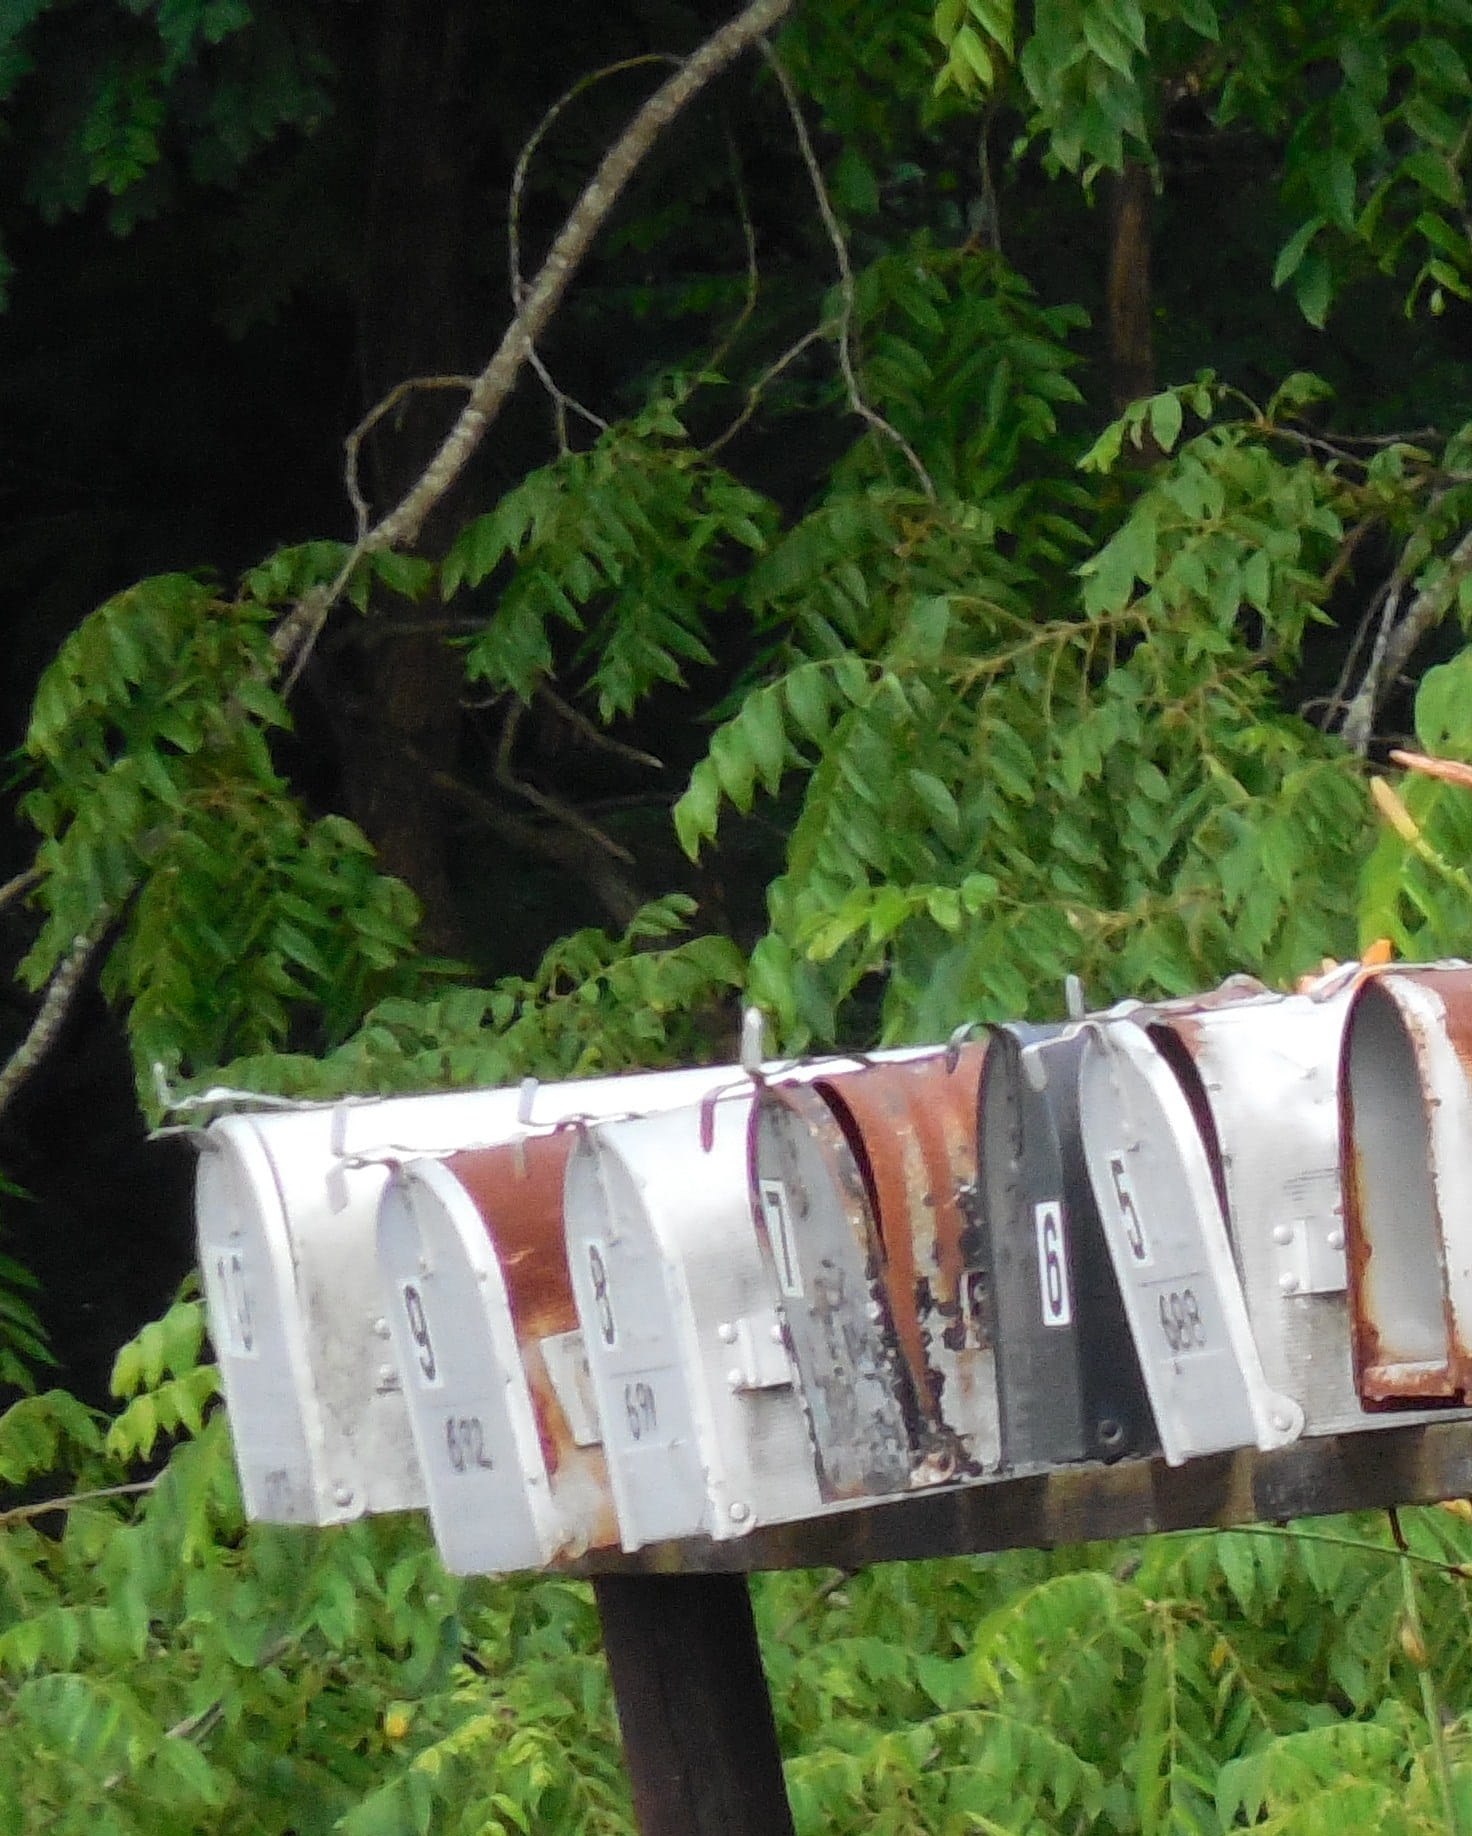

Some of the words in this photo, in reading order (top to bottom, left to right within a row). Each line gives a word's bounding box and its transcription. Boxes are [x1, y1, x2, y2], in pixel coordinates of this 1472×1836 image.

[765, 1190, 794, 1288] 7
[1109, 1159, 1144, 1260] 5
[587, 1244, 614, 1344] 8
[1043, 1212, 1062, 1318] 6
[402, 1285, 435, 1381] 9
